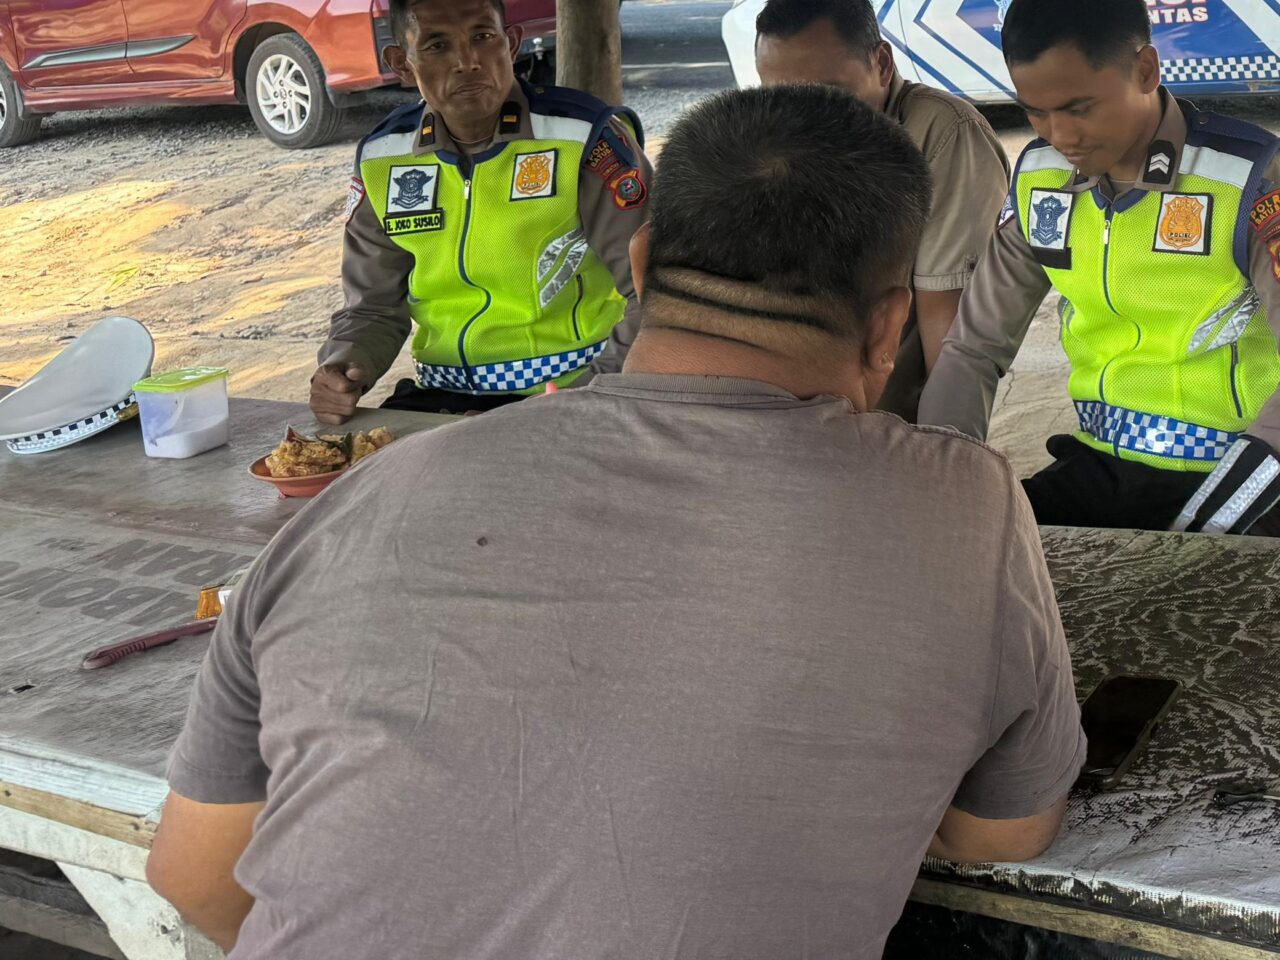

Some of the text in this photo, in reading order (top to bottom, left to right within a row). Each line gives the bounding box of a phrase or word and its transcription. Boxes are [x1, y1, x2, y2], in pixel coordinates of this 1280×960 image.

[1148, 6, 1209, 24] NTAS
[413, 215, 440, 228] SUSILO
[1255, 207, 1274, 225] BATU
